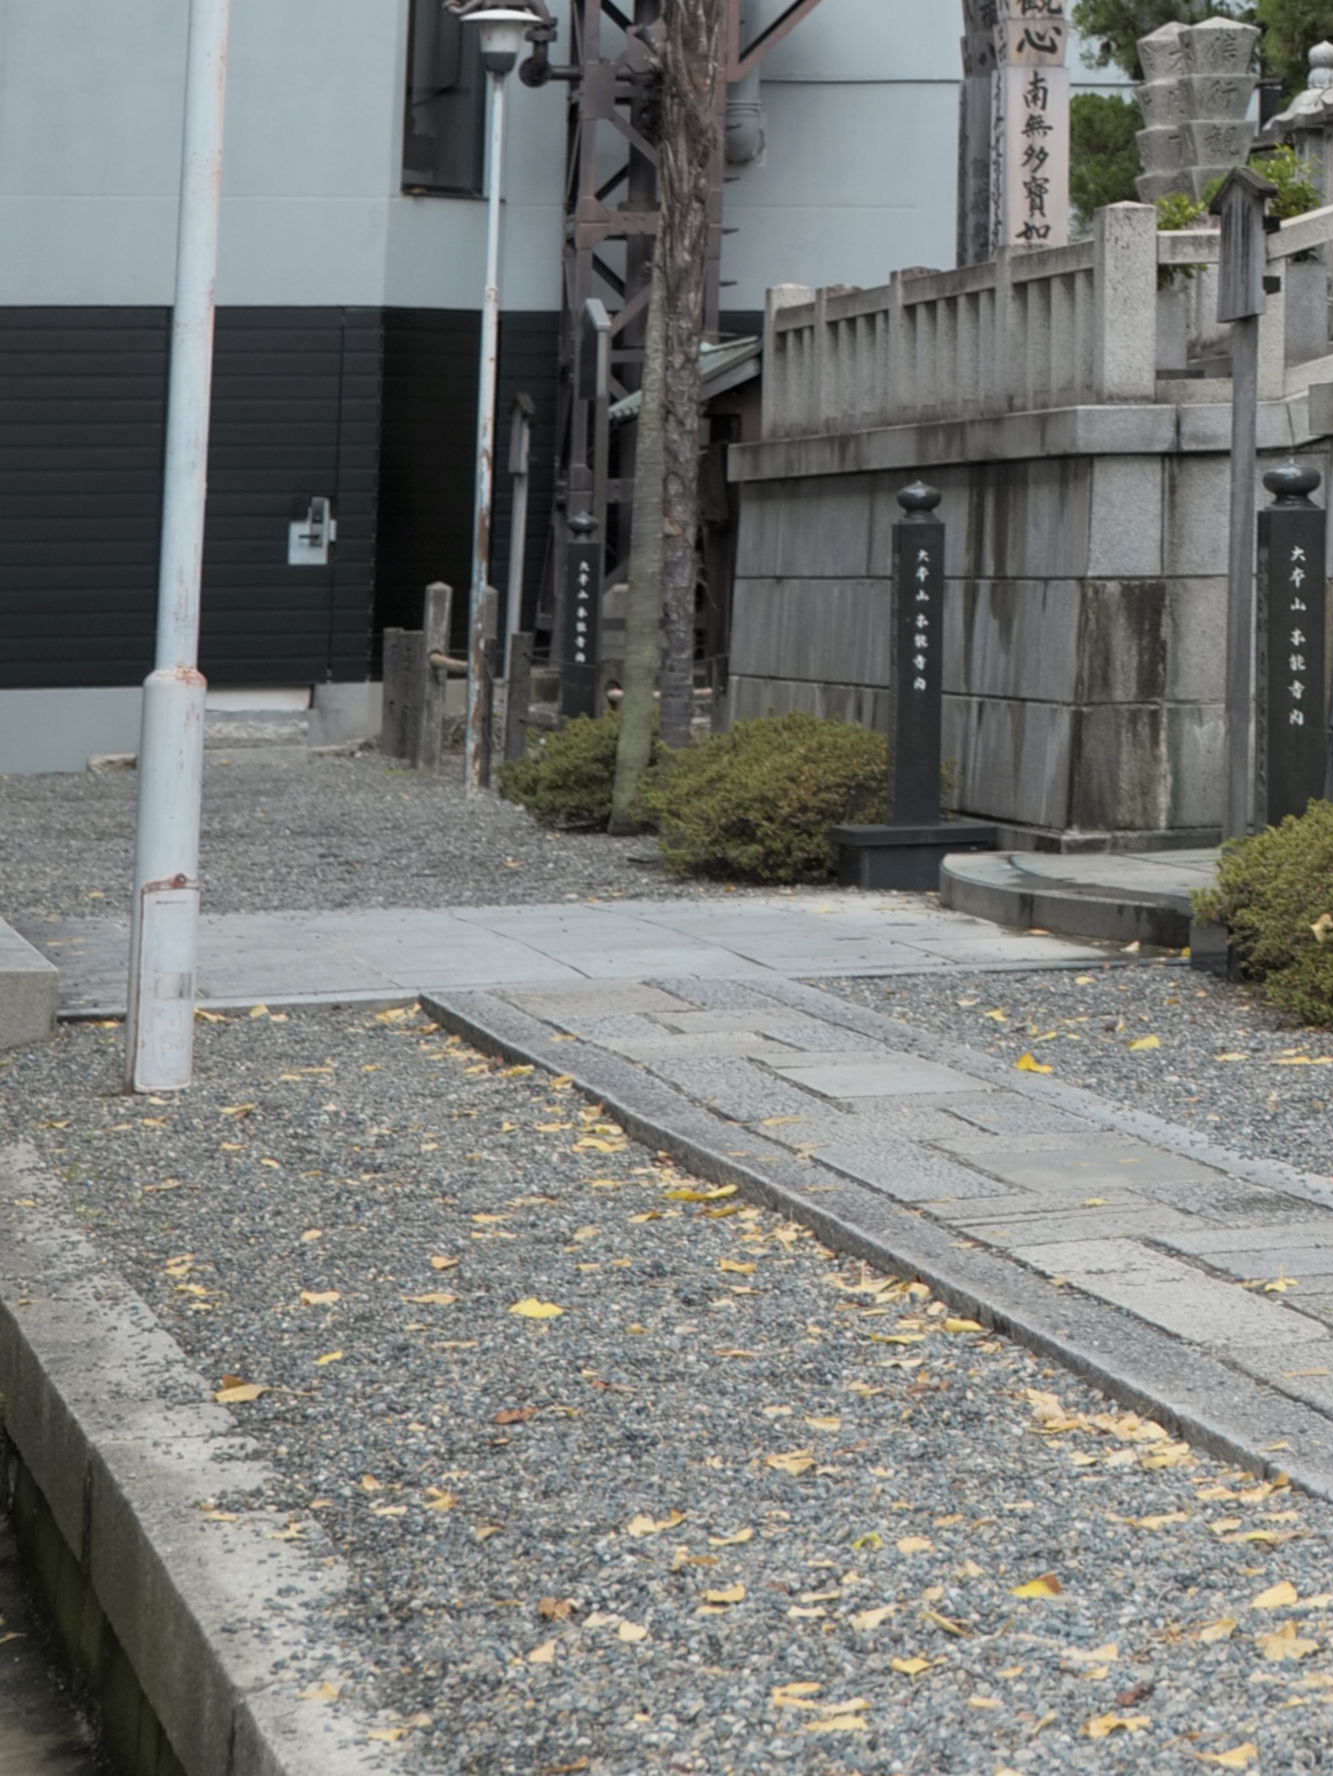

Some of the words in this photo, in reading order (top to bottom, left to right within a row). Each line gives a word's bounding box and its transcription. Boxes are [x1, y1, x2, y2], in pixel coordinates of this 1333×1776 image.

[1015, 69, 1055, 248] 南無多寶如
